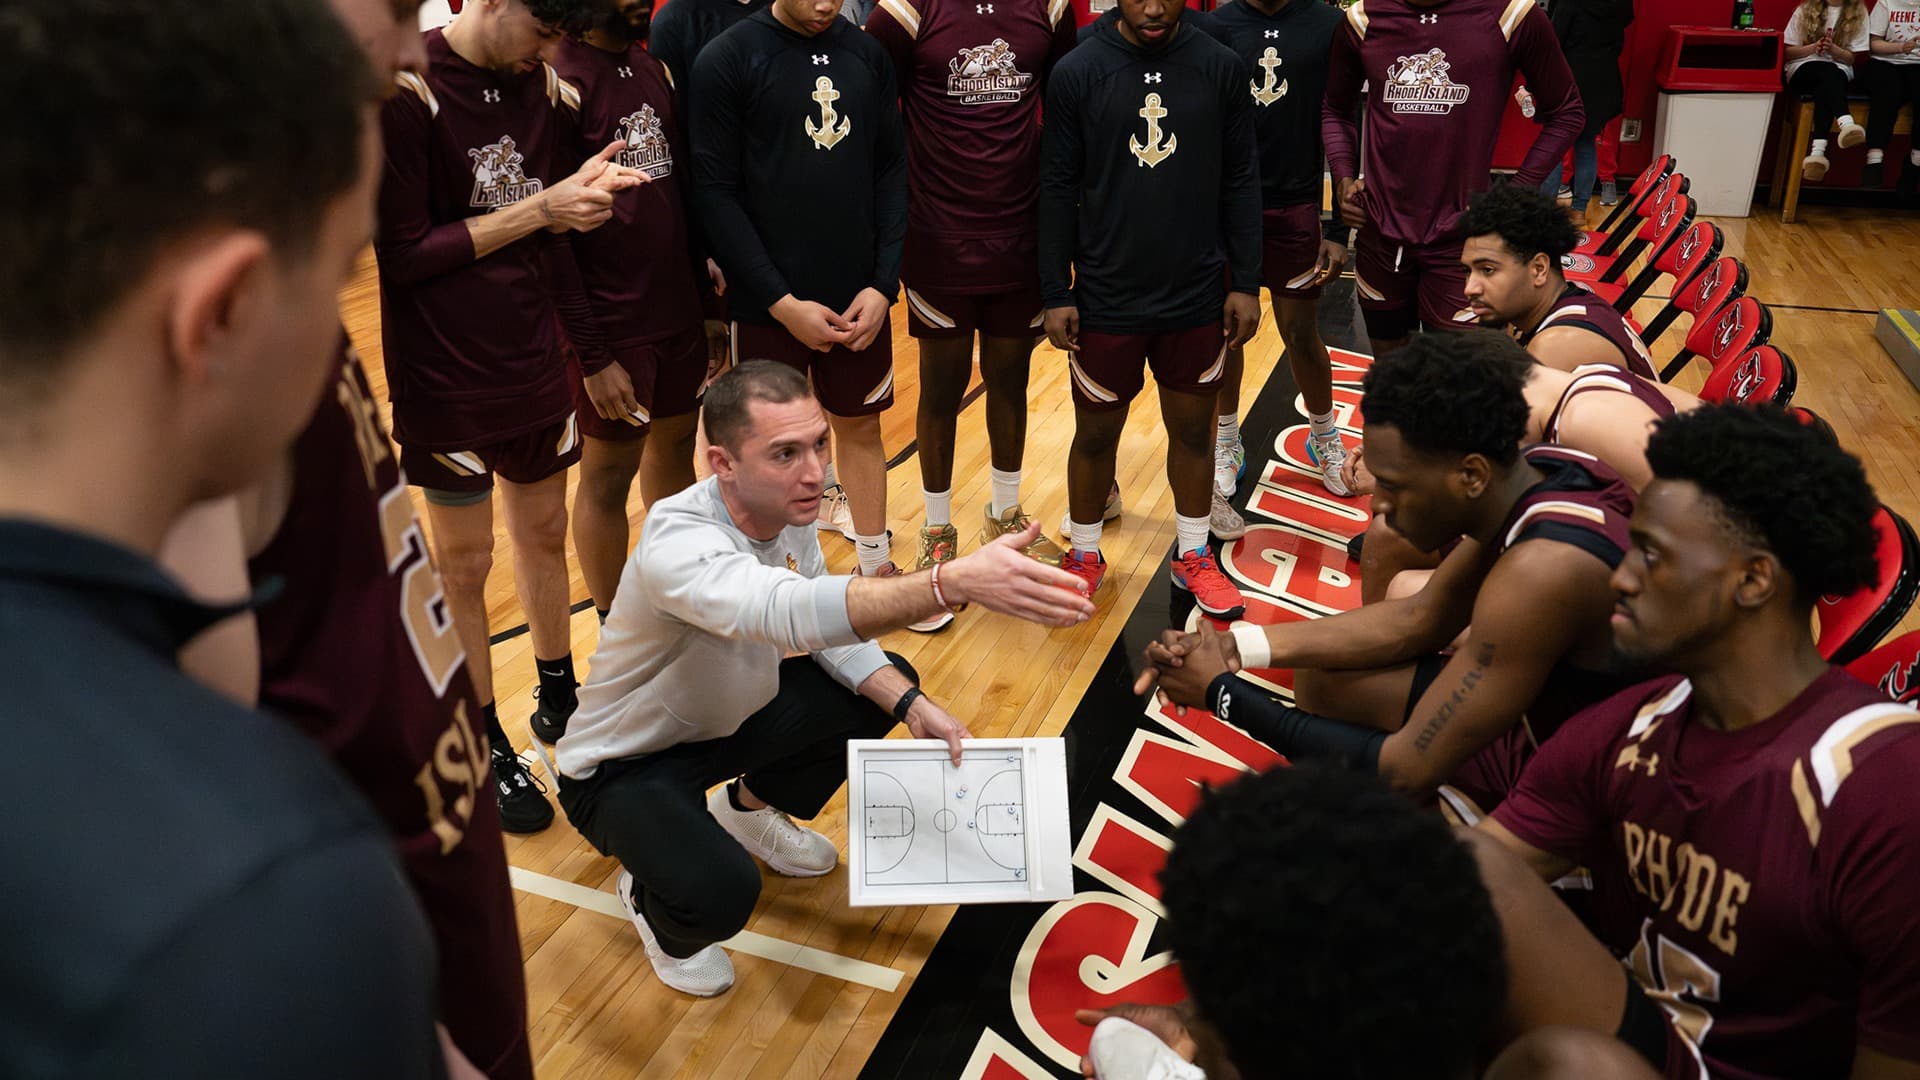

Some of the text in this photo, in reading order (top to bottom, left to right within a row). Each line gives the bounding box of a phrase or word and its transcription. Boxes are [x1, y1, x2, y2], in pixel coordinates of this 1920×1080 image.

[1889, 10, 1916, 23] KEENE
[952, 78, 989, 92] RHODE
[964, 92, 1016, 103] BASKETBALL
[1387, 84, 1466, 100] RHODE ISLAND
[1396, 102, 1445, 112] BASKETBALL
[619, 149, 651, 168] RHODE
